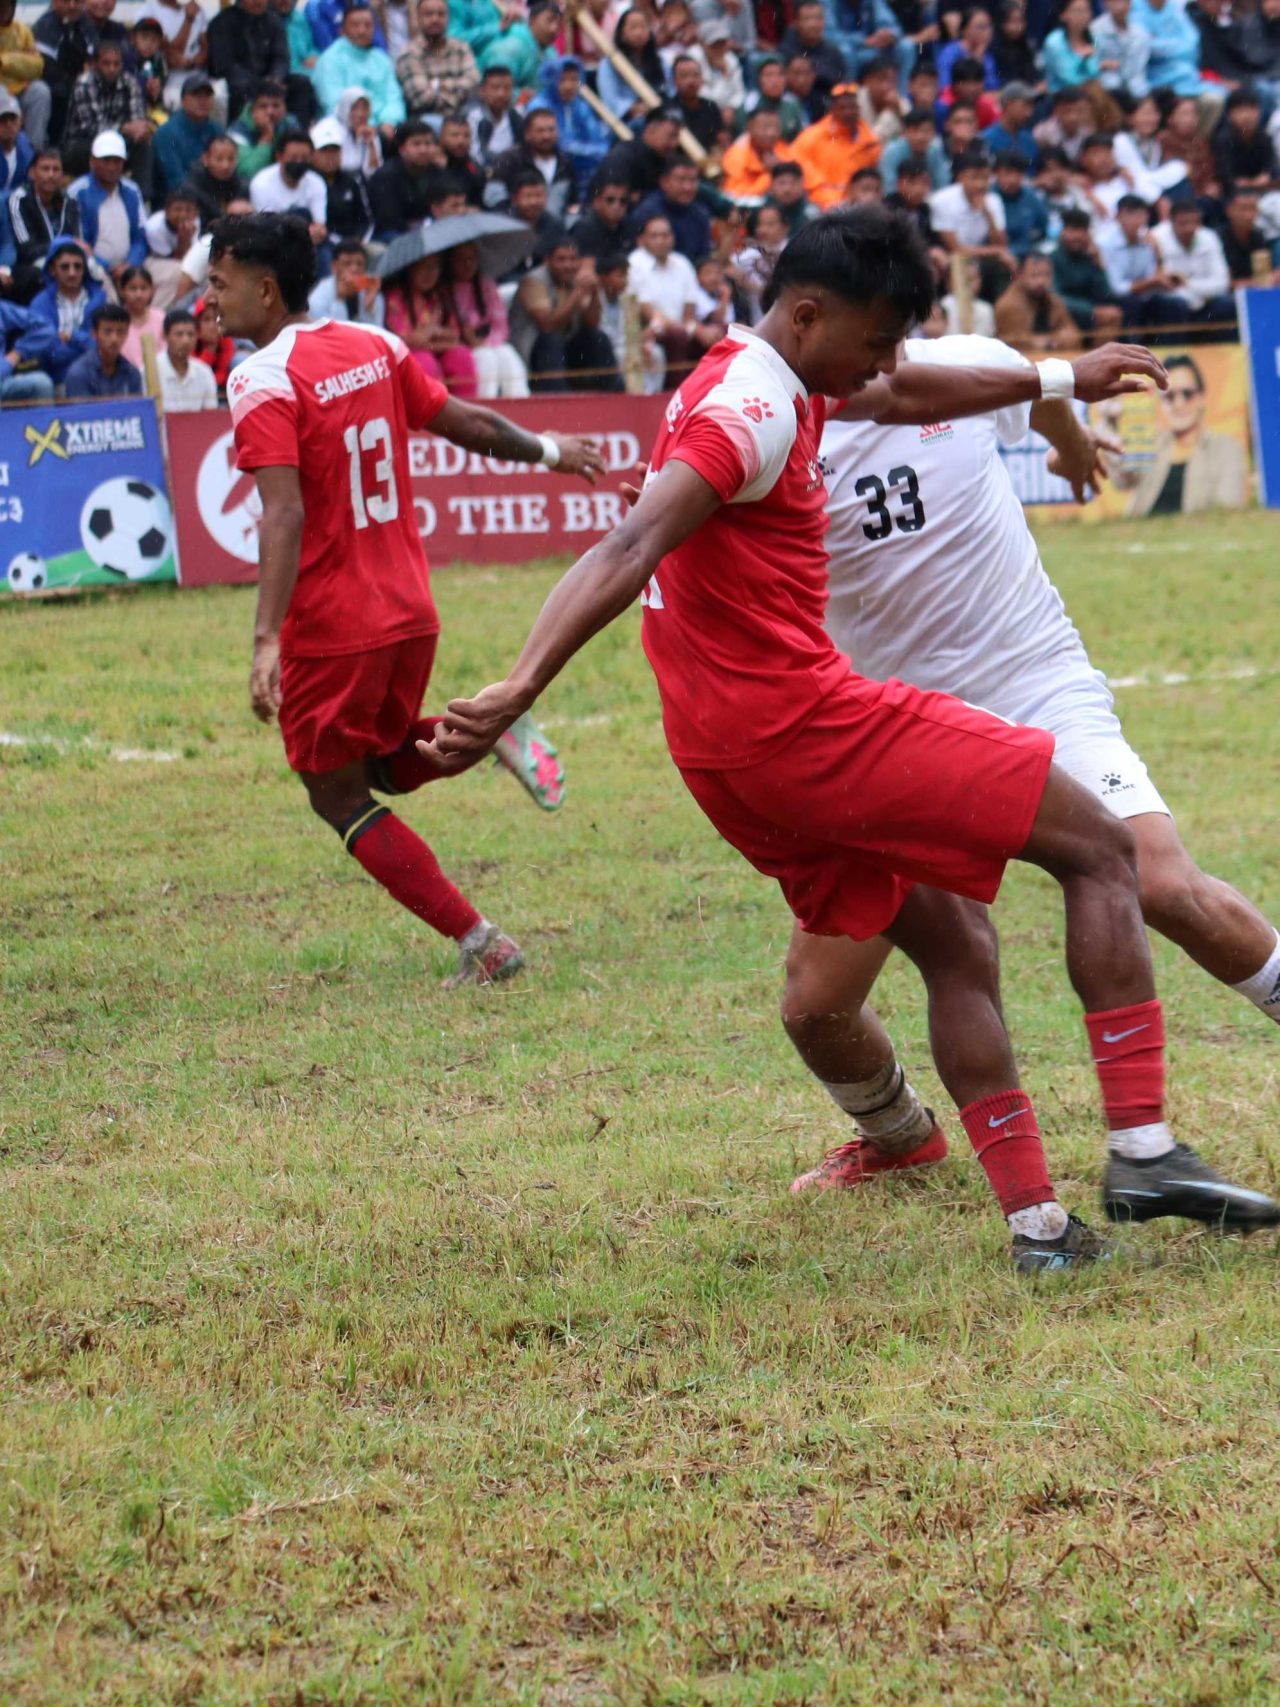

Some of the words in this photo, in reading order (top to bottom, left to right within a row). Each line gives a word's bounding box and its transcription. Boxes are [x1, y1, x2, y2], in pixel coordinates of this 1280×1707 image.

[314, 360, 378, 405] SALHESH
[65, 416, 144, 447] XTREME
[344, 417, 399, 530] 13
[413, 496, 437, 537] O
[448, 493, 549, 535] THE
[560, 491, 632, 532] BR
[855, 465, 926, 541] 33
[1101, 783, 1136, 796] KELME
